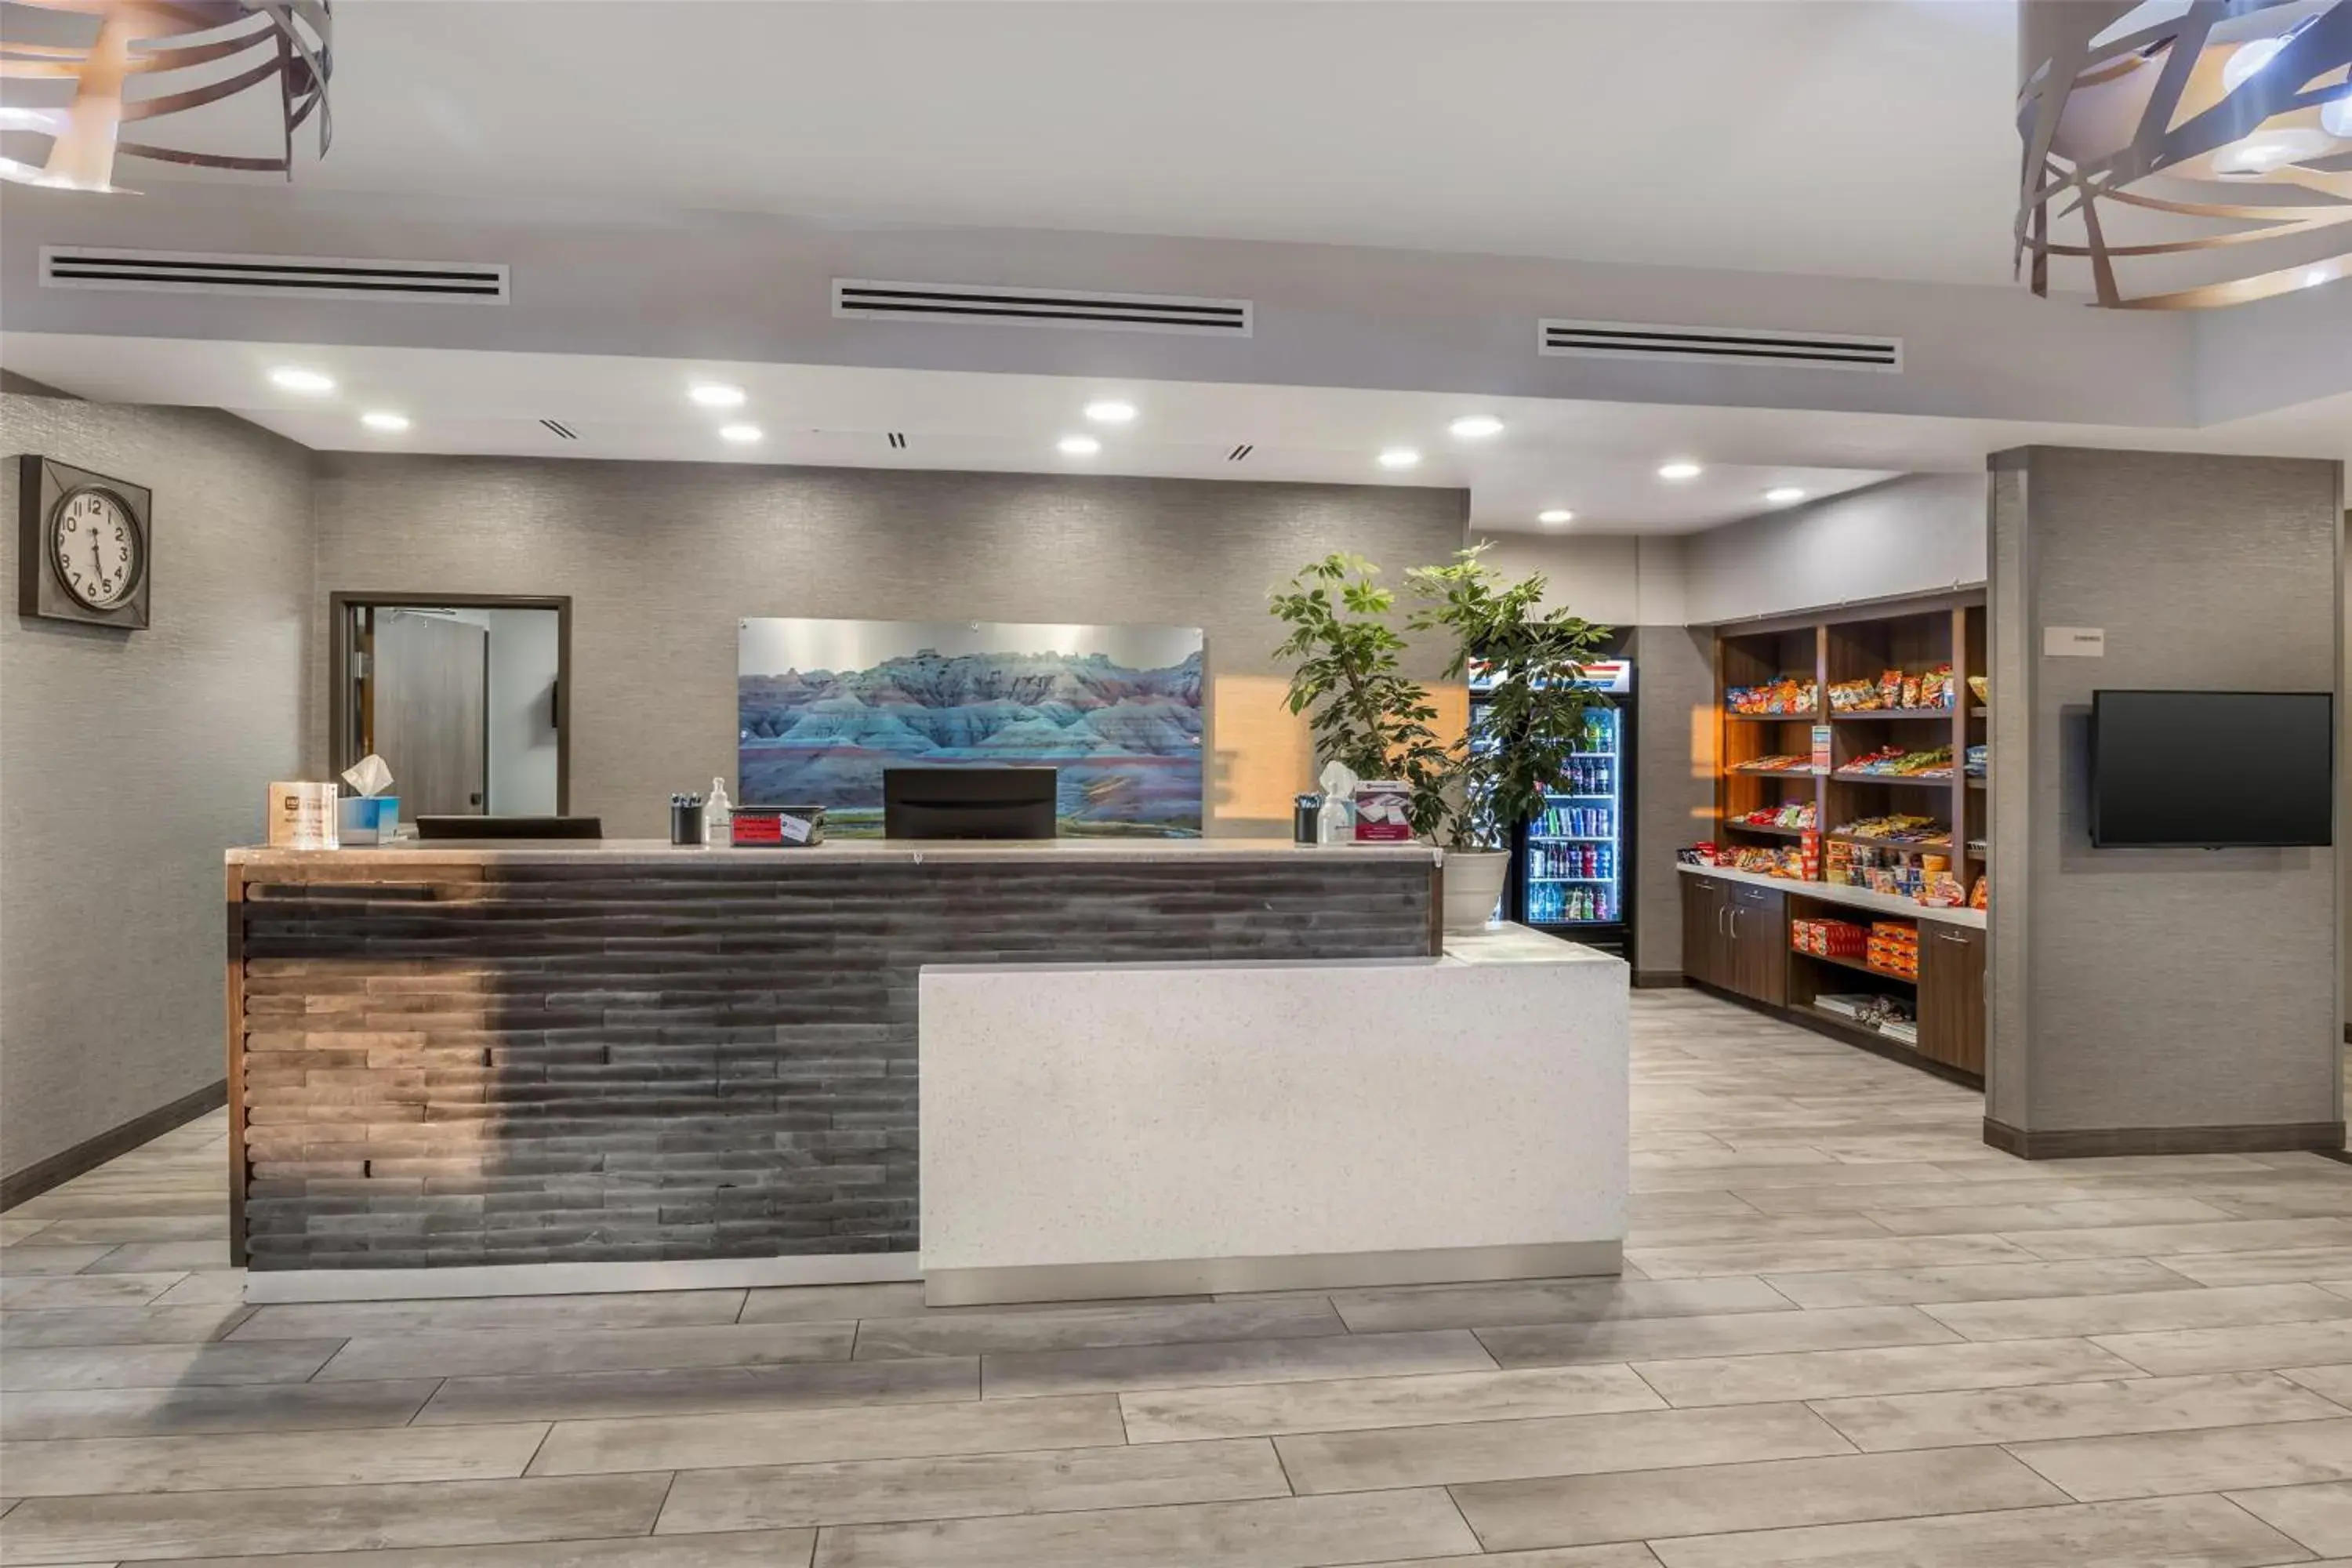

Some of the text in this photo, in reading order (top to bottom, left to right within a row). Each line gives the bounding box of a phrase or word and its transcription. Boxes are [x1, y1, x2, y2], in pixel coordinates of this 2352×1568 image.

[88, 498, 101, 515] 12
[115, 527, 124, 542] 2
[119, 546, 128, 561] 3
[62, 554, 70, 569] 8
[72, 572, 82, 588] 7
[114, 565, 122, 580] 4
[87, 582, 96, 597] 6
[102, 578, 112, 593] 5
